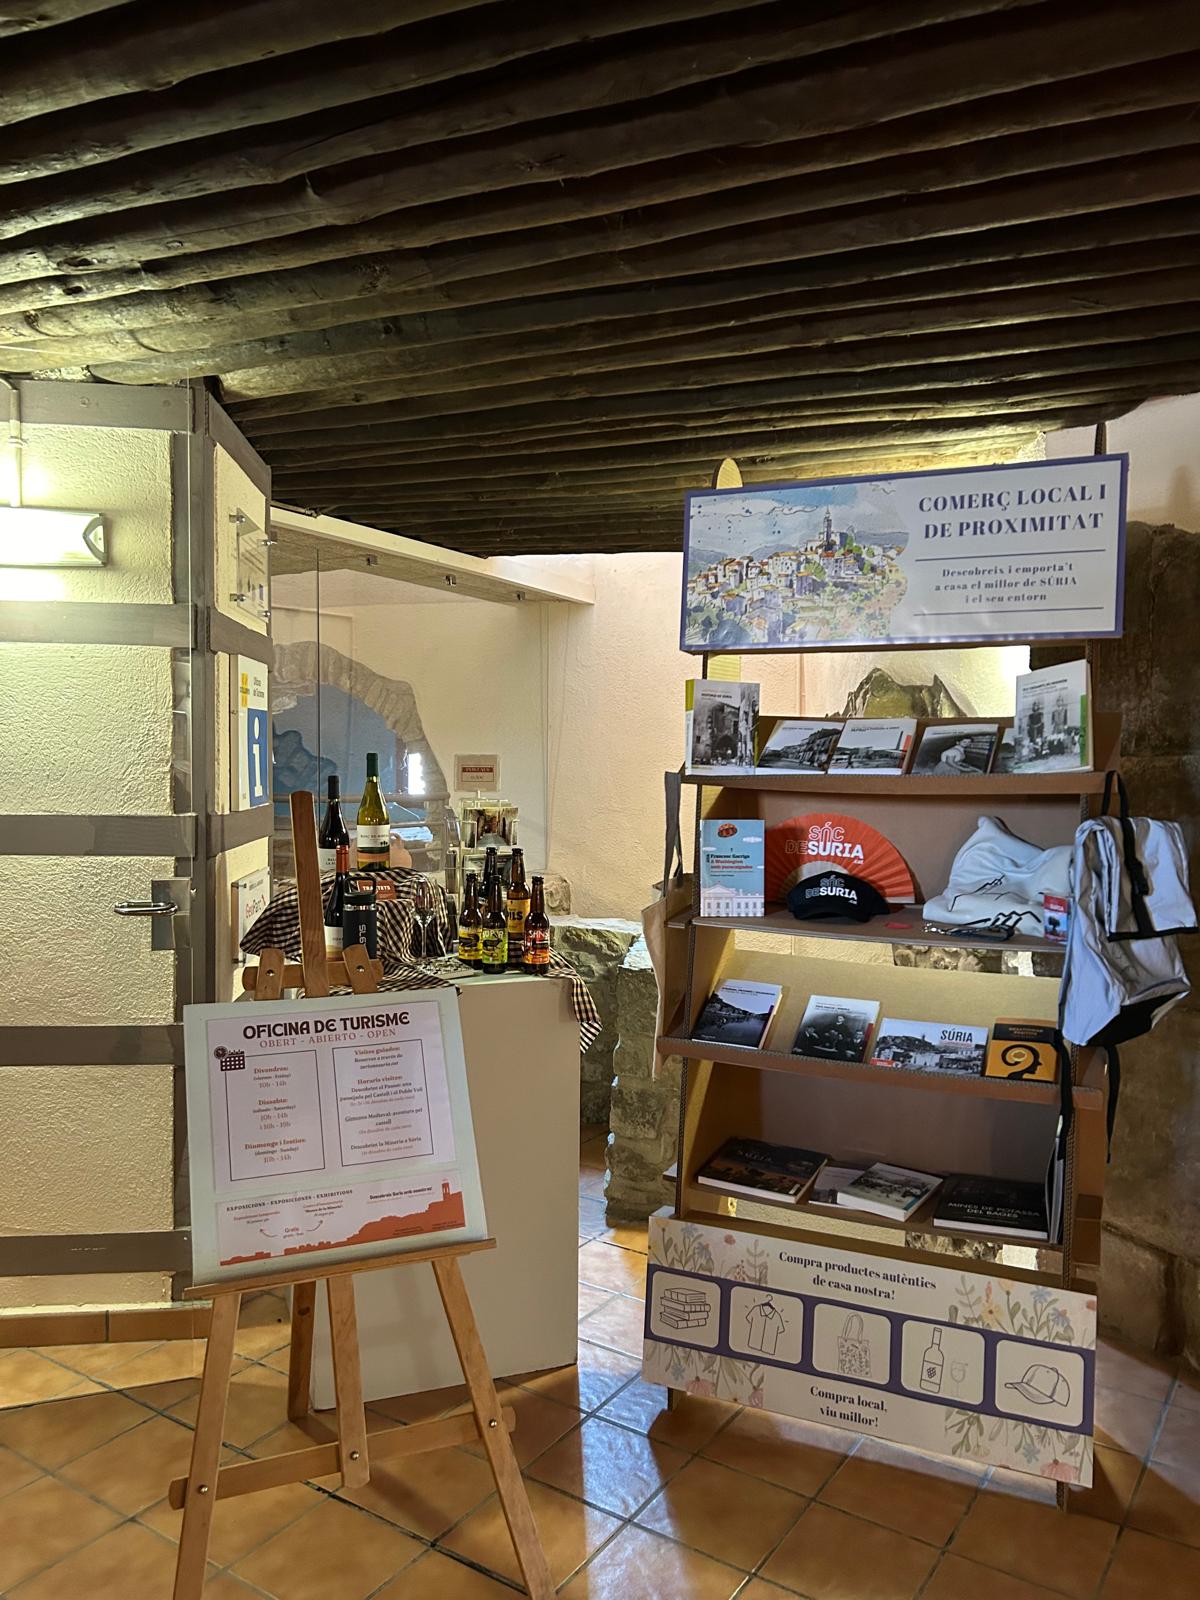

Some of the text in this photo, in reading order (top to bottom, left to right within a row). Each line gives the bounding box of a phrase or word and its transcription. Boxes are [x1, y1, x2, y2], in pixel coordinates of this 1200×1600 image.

[919, 483, 1106, 512] COMERÇ LOCAL I
[924, 512, 1104, 539] DE PROXIMITAT
[942, 565, 1005, 577] Descobreix
[1015, 562, 1073, 576] emporta't
[944, 583, 968, 591] casa
[971, 580, 981, 590] el
[984, 578, 1020, 590] millor
[1023, 577, 1037, 588] de
[1039, 576, 1077, 587] SÚRIA
[972, 594, 982, 603] el
[986, 595, 1004, 603] seu
[1007, 593, 1047, 602] entorn
[243, 1011, 410, 1039] OFICINA DE TURISME
[940, 1027, 974, 1043] SÚRIA
[259, 1028, 397, 1048] OBERT ABIERTO OPEN
[226, 1202, 266, 1212] EXPOSICIONS
[779, 1251, 937, 1290] Compra productes autèntics
[812, 1274, 895, 1301] de casa nostra!
[810, 1385, 888, 1412] Compra local,
[820, 1406, 879, 1428] viu millor!
